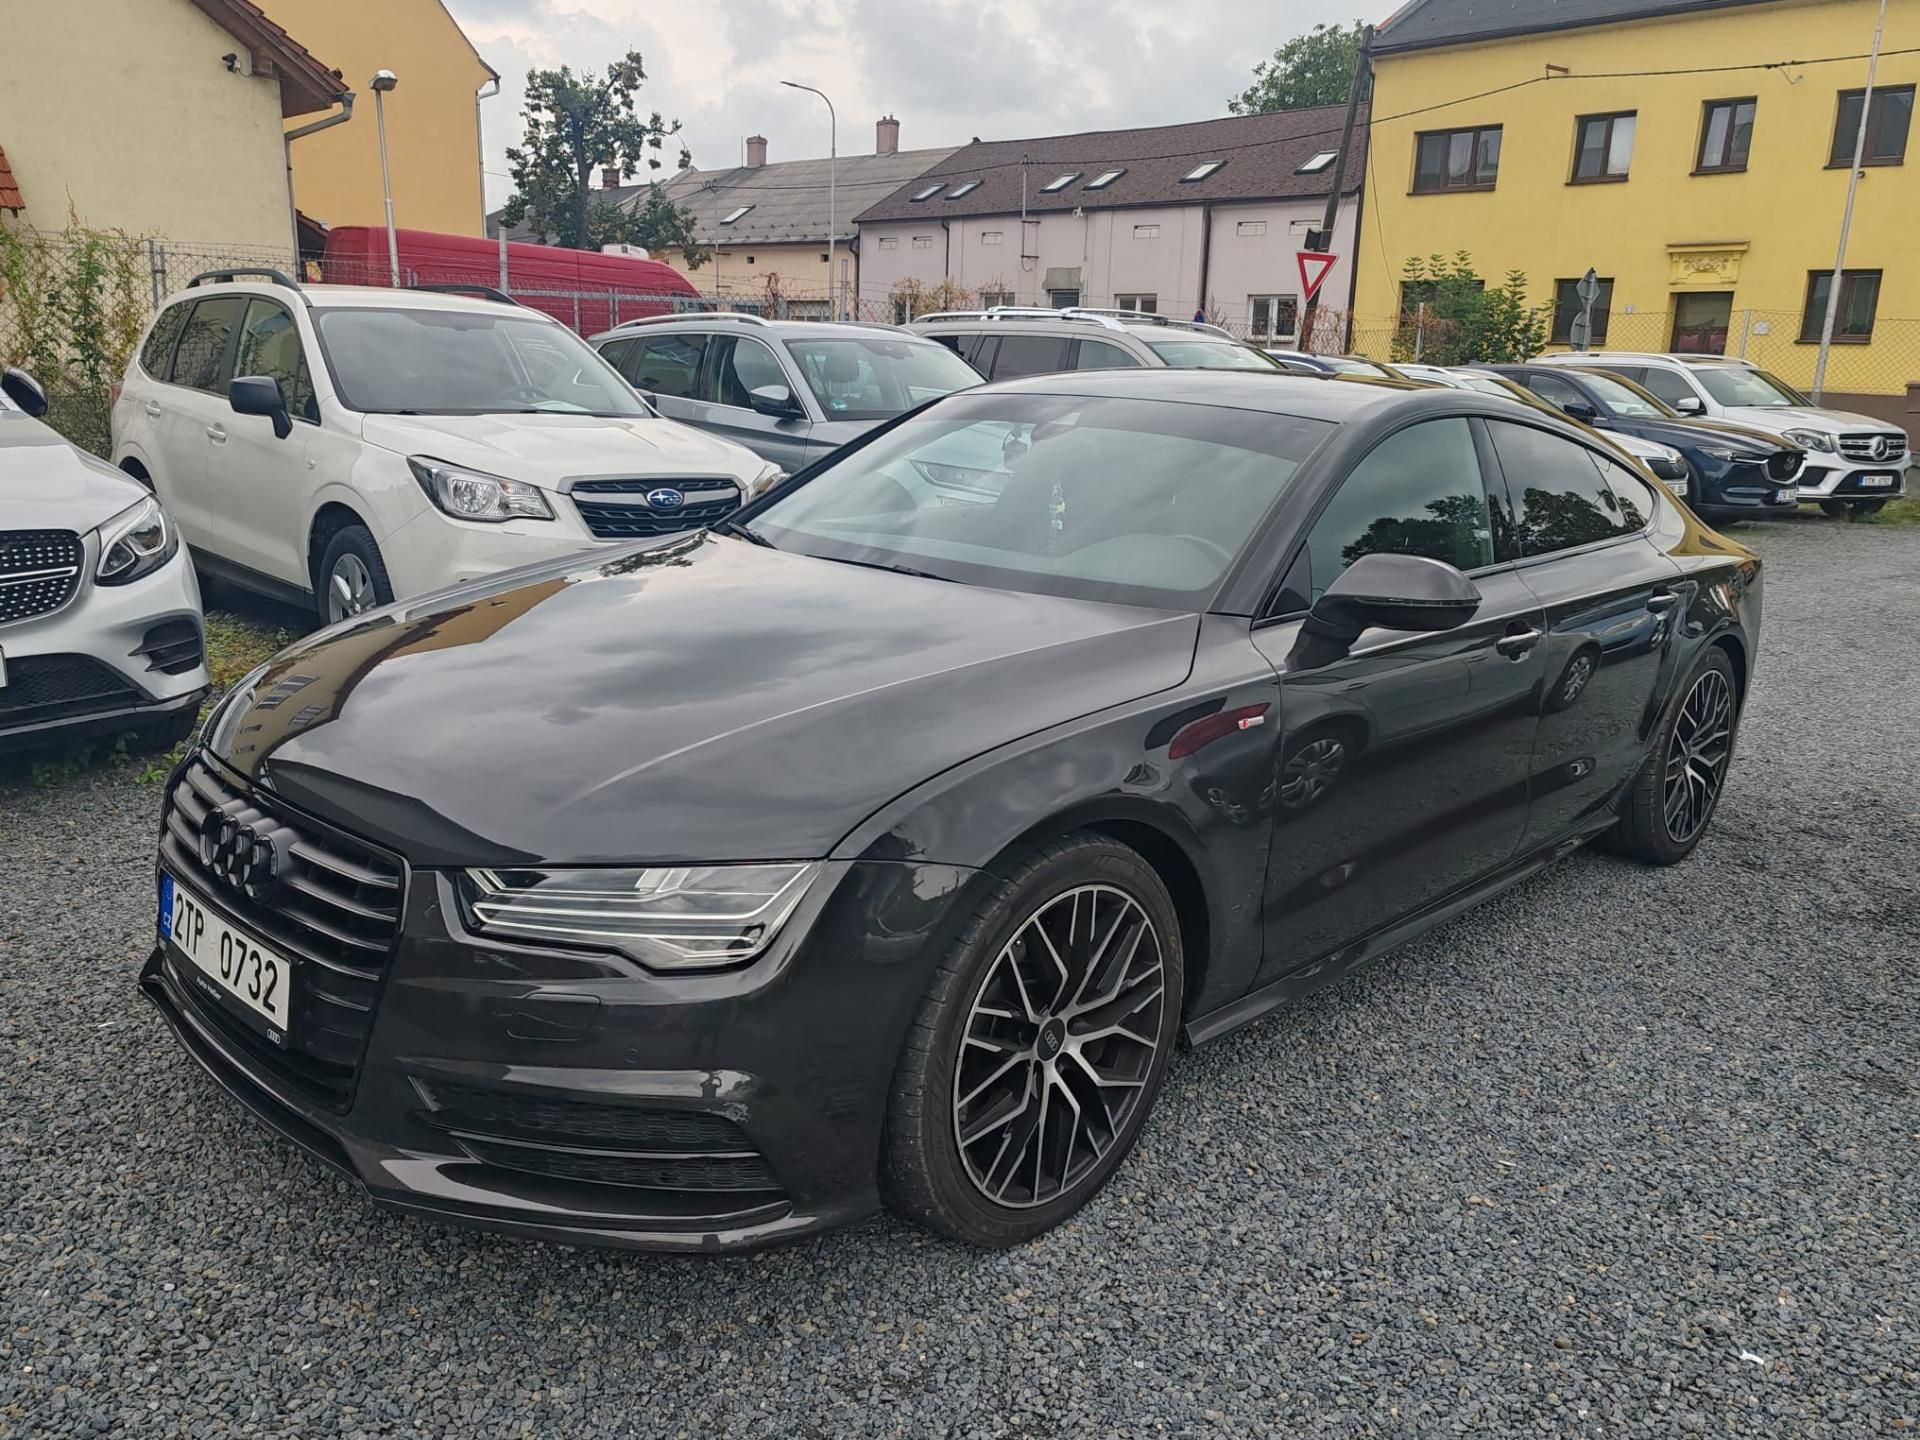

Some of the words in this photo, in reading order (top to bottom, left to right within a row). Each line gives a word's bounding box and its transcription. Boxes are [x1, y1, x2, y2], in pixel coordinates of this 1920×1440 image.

[163, 911, 172, 929] CZ
[174, 893, 204, 955] 2TP
[220, 930, 278, 1015] 0732
